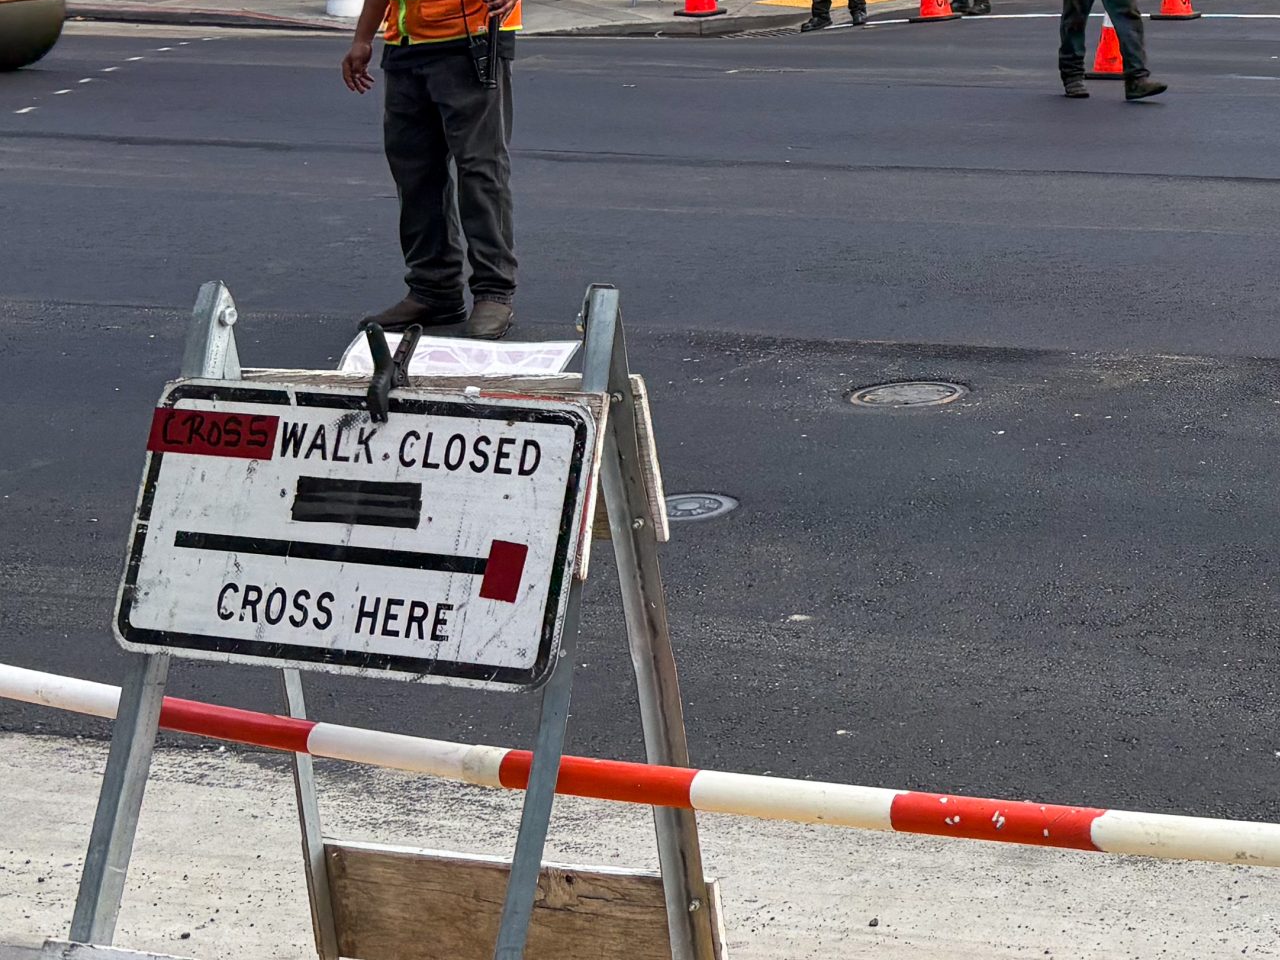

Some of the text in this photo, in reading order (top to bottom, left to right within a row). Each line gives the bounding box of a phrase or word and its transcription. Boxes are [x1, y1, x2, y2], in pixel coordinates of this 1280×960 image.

[161, 411, 542, 476] CROSS WALK CLOSED
[217, 582, 454, 642] CROSS HERE
